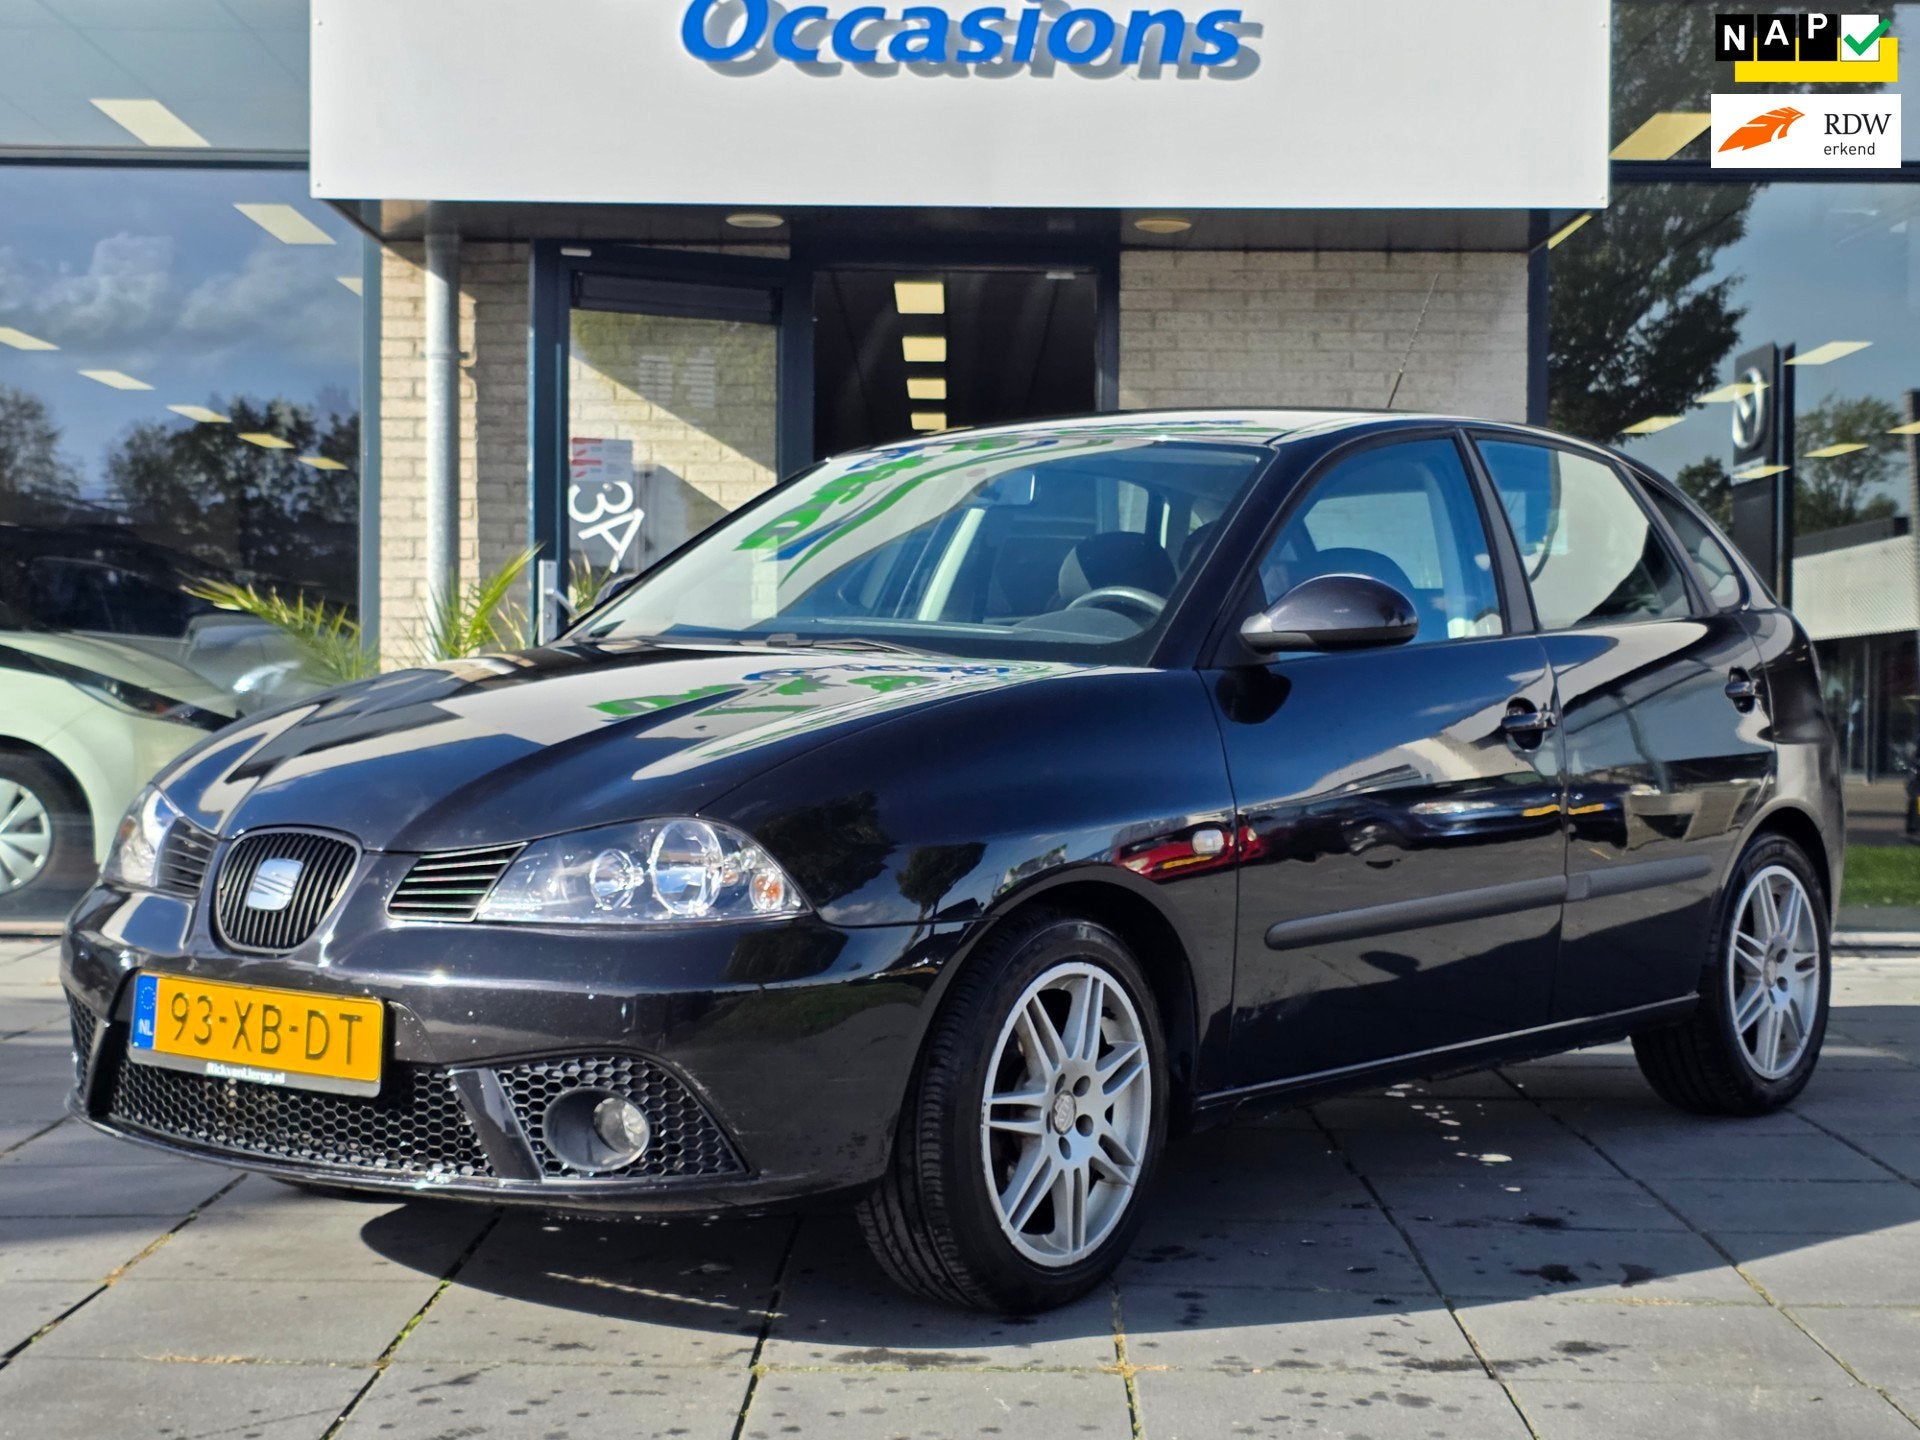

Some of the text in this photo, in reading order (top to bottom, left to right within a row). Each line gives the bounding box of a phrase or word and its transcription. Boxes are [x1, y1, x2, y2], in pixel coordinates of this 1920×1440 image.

[681, 0, 1242, 66] Occasions
[568, 480, 645, 573] 3A
[138, 1019, 153, 1036] NL
[171, 992, 363, 1065] 93-XB-DT
